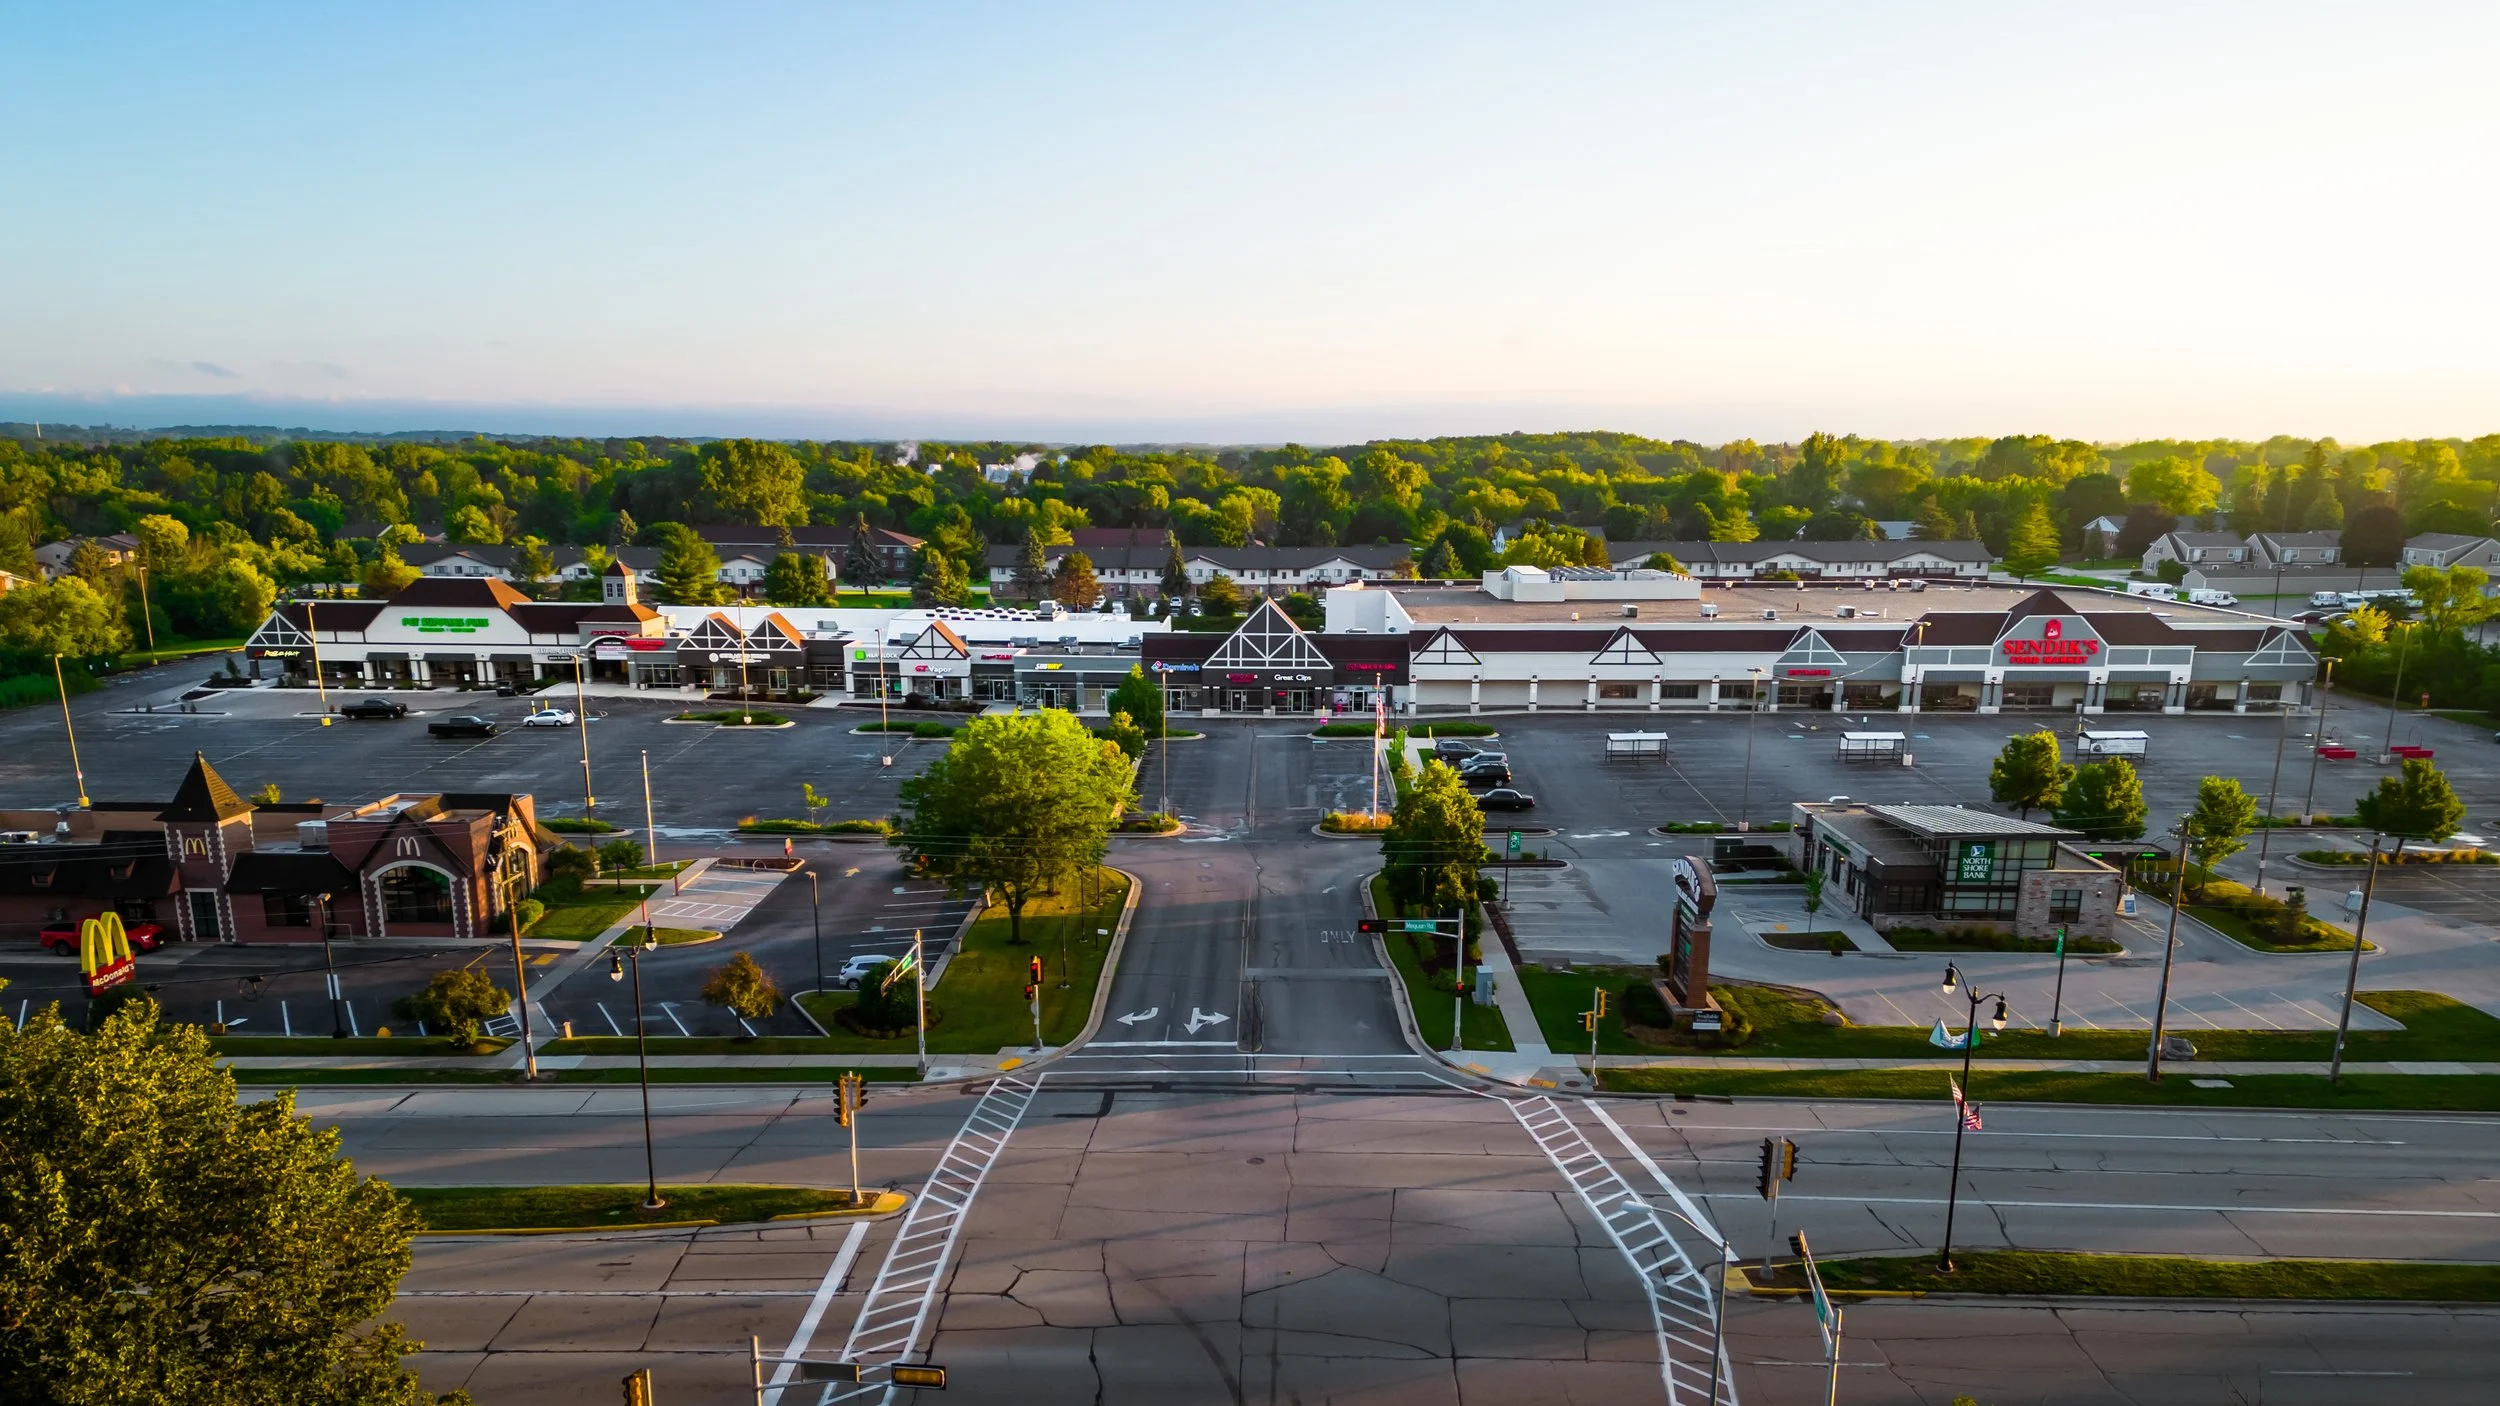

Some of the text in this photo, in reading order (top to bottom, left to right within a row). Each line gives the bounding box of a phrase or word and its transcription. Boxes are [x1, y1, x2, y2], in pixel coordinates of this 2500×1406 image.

[2002, 639, 2098, 655] SENDIK'S
[2009, 656, 2088, 664] FOOD MARKET
[928, 665, 952, 674] Vapor
[1162, 663, 1200, 671] Domino's
[1296, 674, 1312, 682] Clips
[1320, 930, 1356, 943] ONLY
[92, 963, 135, 987] McDonald's
